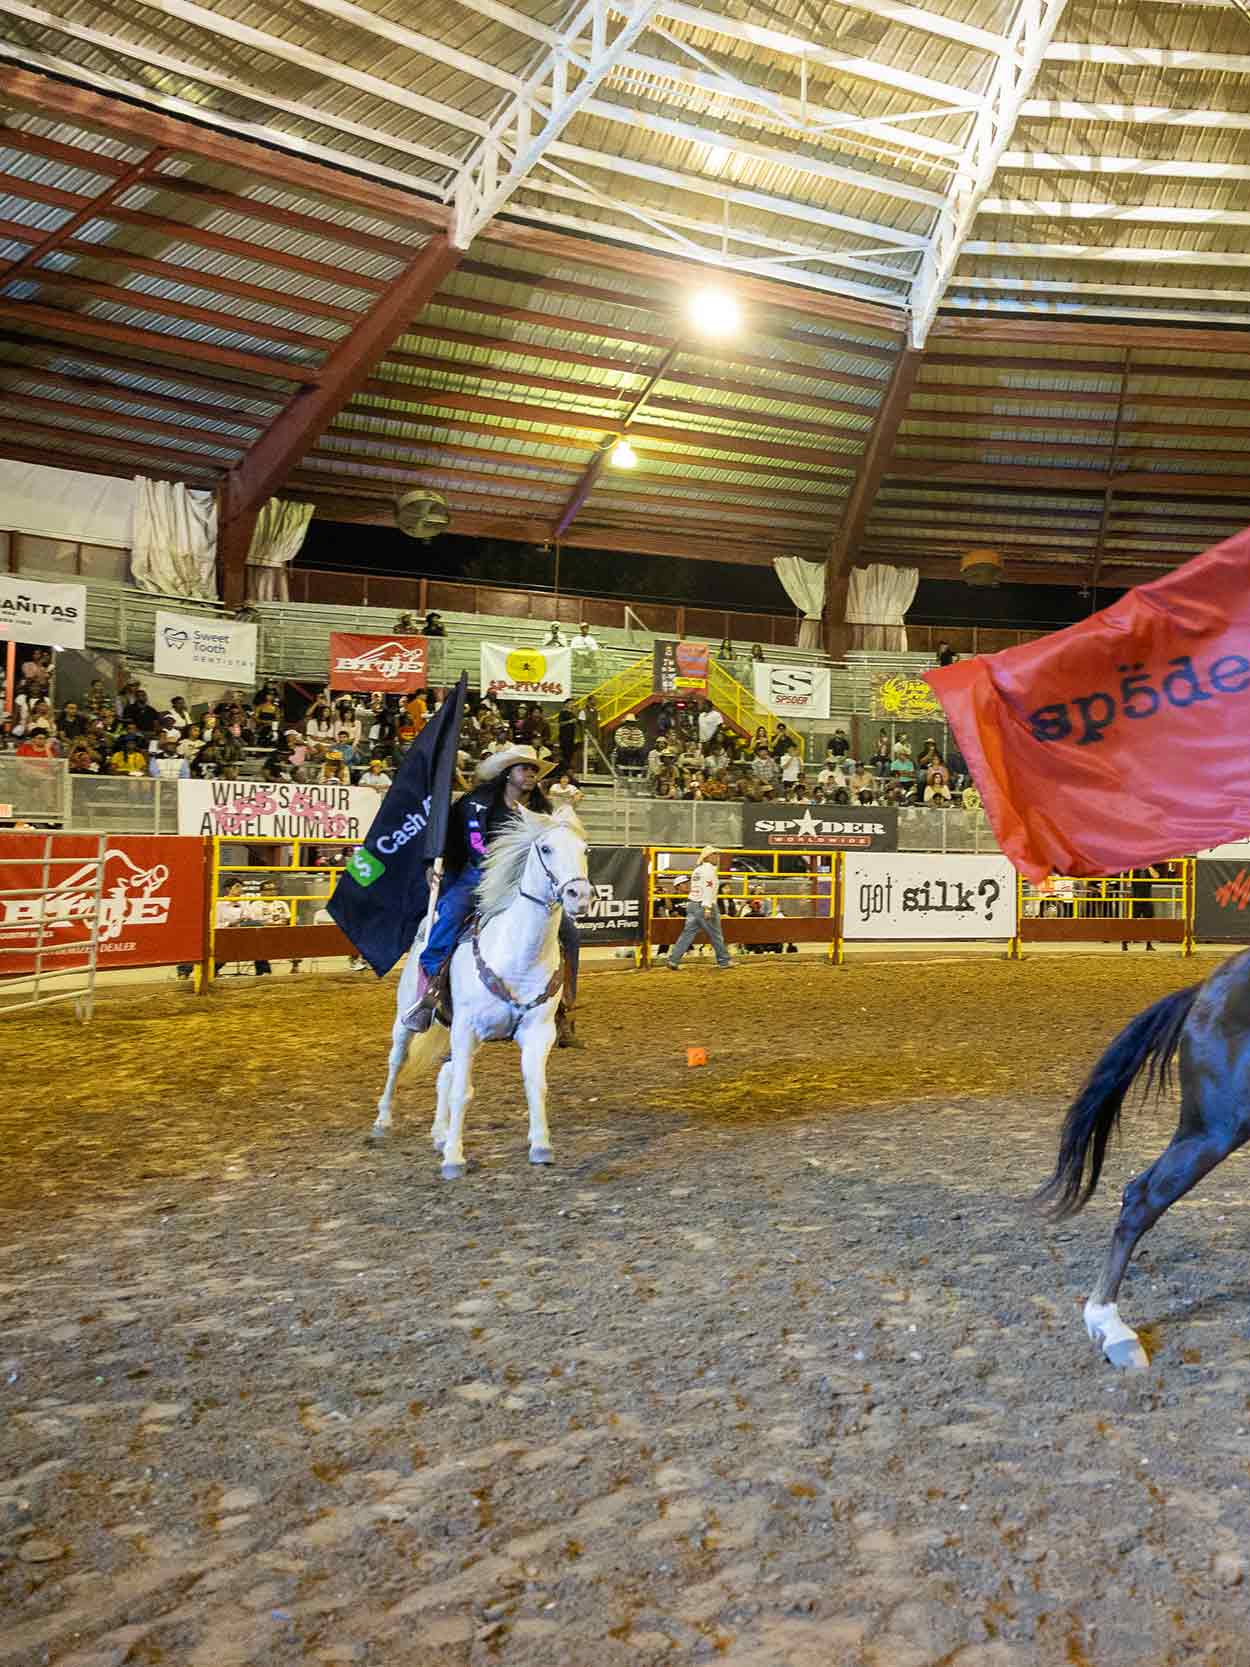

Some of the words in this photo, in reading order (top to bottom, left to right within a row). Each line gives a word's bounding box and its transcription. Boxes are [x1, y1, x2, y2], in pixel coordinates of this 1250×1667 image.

[0, 595, 78, 618] AÑITAS
[192, 641, 225, 653] Tooth
[193, 630, 230, 644] Sweet
[376, 813, 427, 854] Cash
[859, 876, 892, 921] got
[902, 879, 1000, 921] silk?
